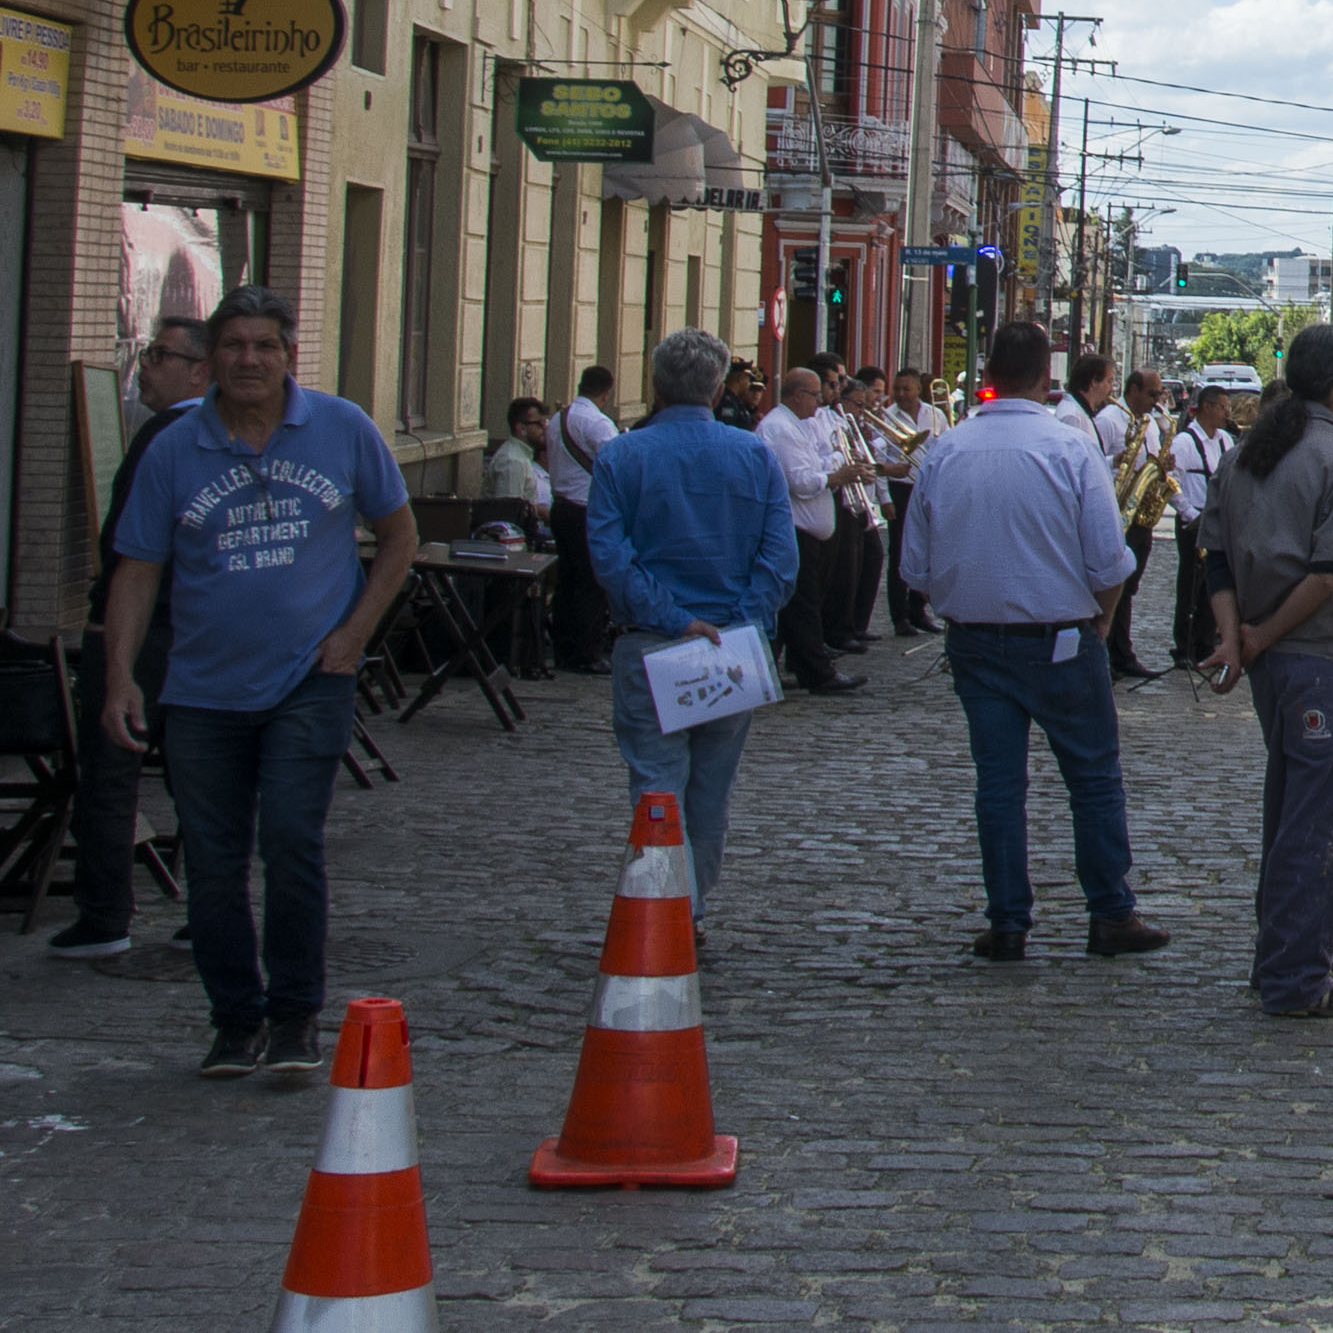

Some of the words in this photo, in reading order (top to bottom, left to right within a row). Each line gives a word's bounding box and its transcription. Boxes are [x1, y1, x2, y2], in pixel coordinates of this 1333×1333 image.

[148, 3, 321, 58] Brasileirinho
[177, 59, 199, 73] bar
[213, 60, 291, 74] restaurante
[552, 84, 622, 102] SEBO
[541, 100, 632, 120] SANTOS
[205, 114, 246, 145] DOMINGO
[181, 464, 254, 530] TRAVELLER
[270, 459, 346, 512] COLLECTION
[226, 496, 302, 528] AUTHENTIC
[217, 519, 311, 551] DEPARTMENT
[255, 546, 295, 569] BRAND
